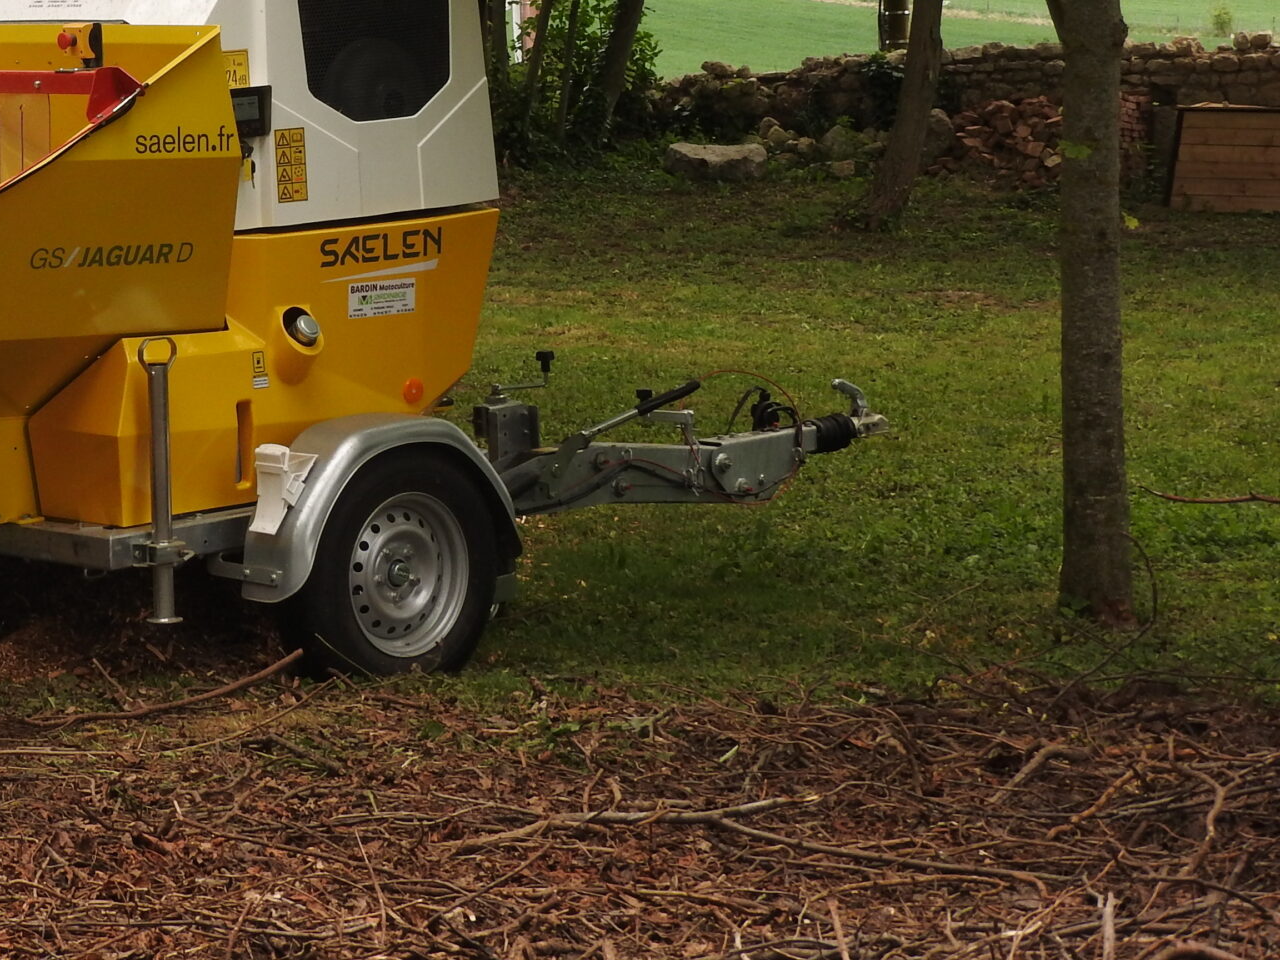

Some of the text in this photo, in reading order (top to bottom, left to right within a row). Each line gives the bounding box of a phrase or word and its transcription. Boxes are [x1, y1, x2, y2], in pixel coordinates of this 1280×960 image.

[135, 125, 234, 154] saelen.fr
[176, 242, 194, 263] D
[320, 226, 442, 268] SAELEN
[350, 283, 378, 294] BARDIN
